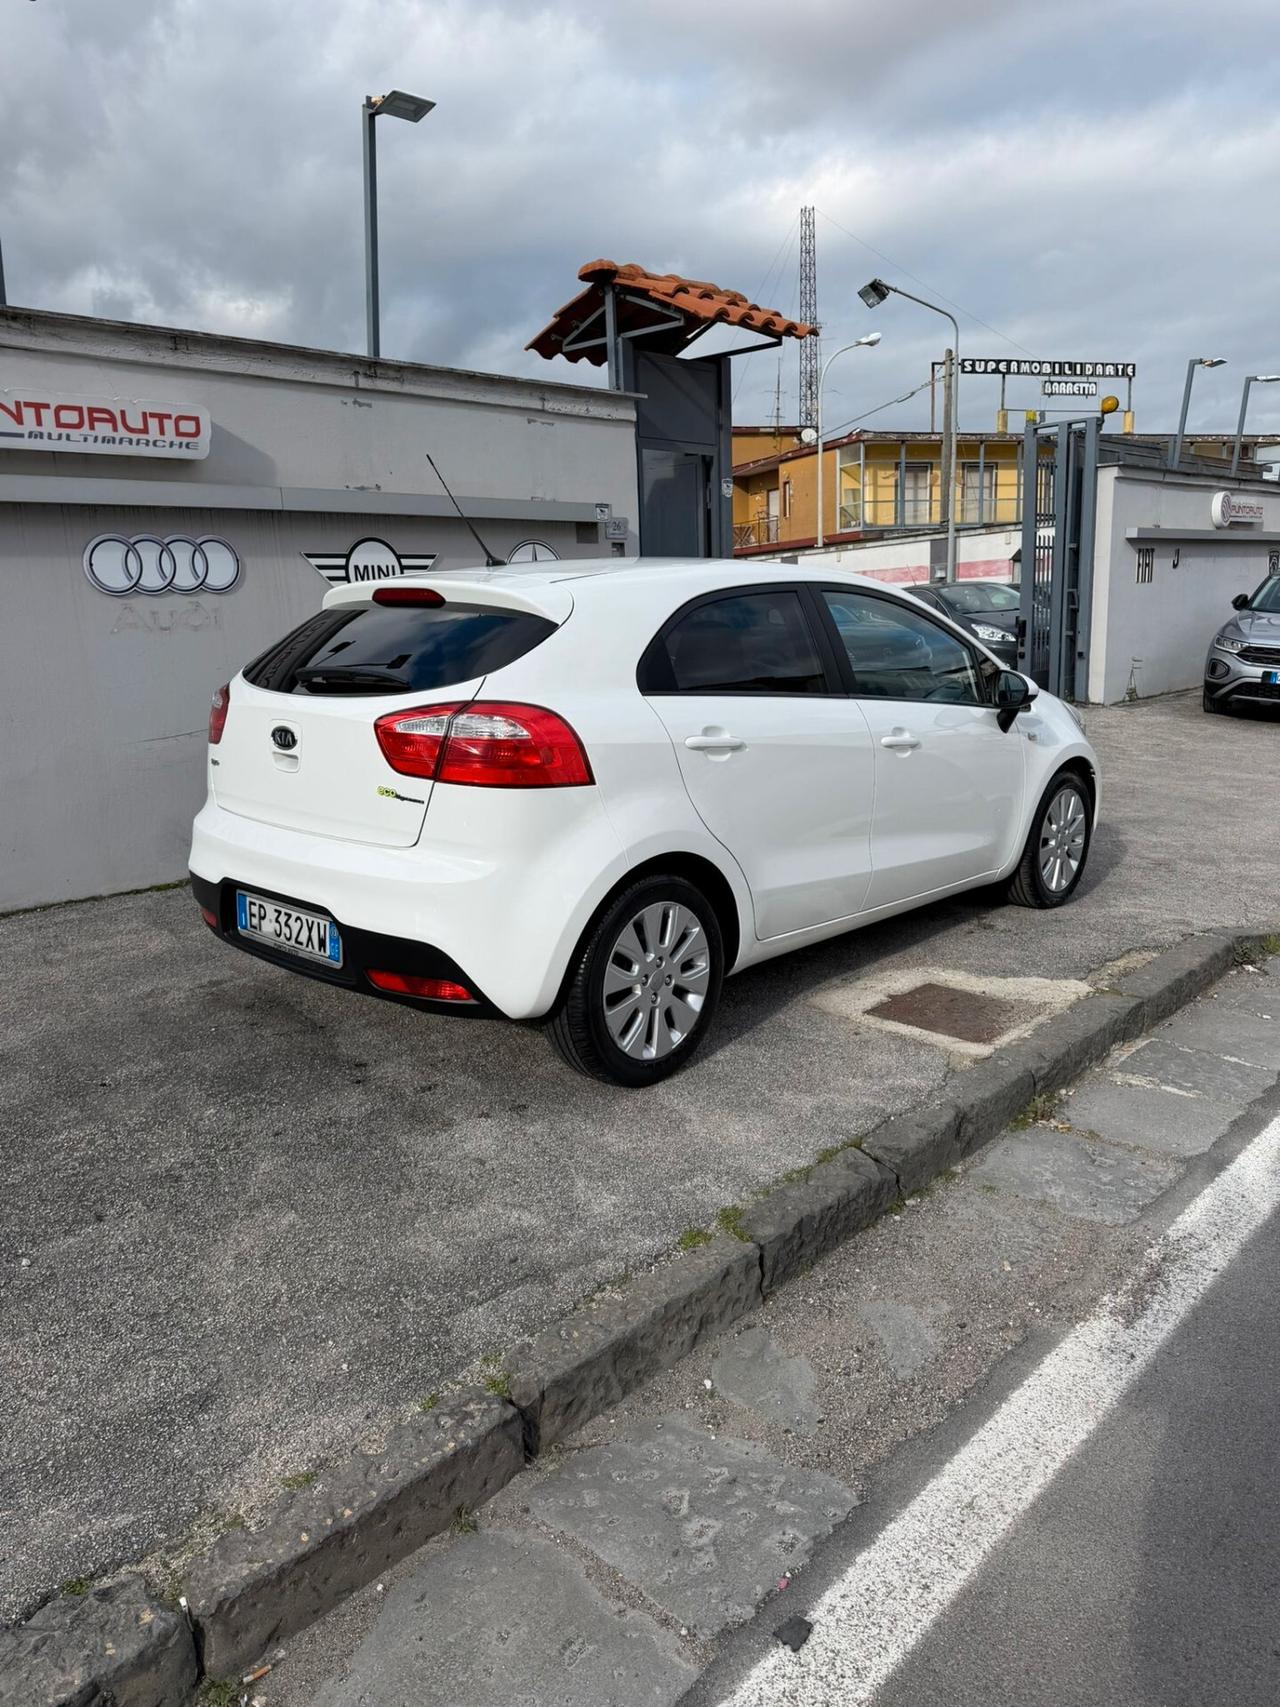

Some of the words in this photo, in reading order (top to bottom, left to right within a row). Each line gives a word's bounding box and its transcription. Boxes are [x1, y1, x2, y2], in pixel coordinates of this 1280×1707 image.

[1044, 381, 1097, 395] BARRETTA
[27, 430, 200, 450] MULTIMARCHE
[353, 564, 396, 582] MINI
[1136, 548, 1155, 584] FIAT
[274, 729, 293, 746] KIA
[248, 900, 267, 932] EP
[273, 909, 328, 954] 332XW
